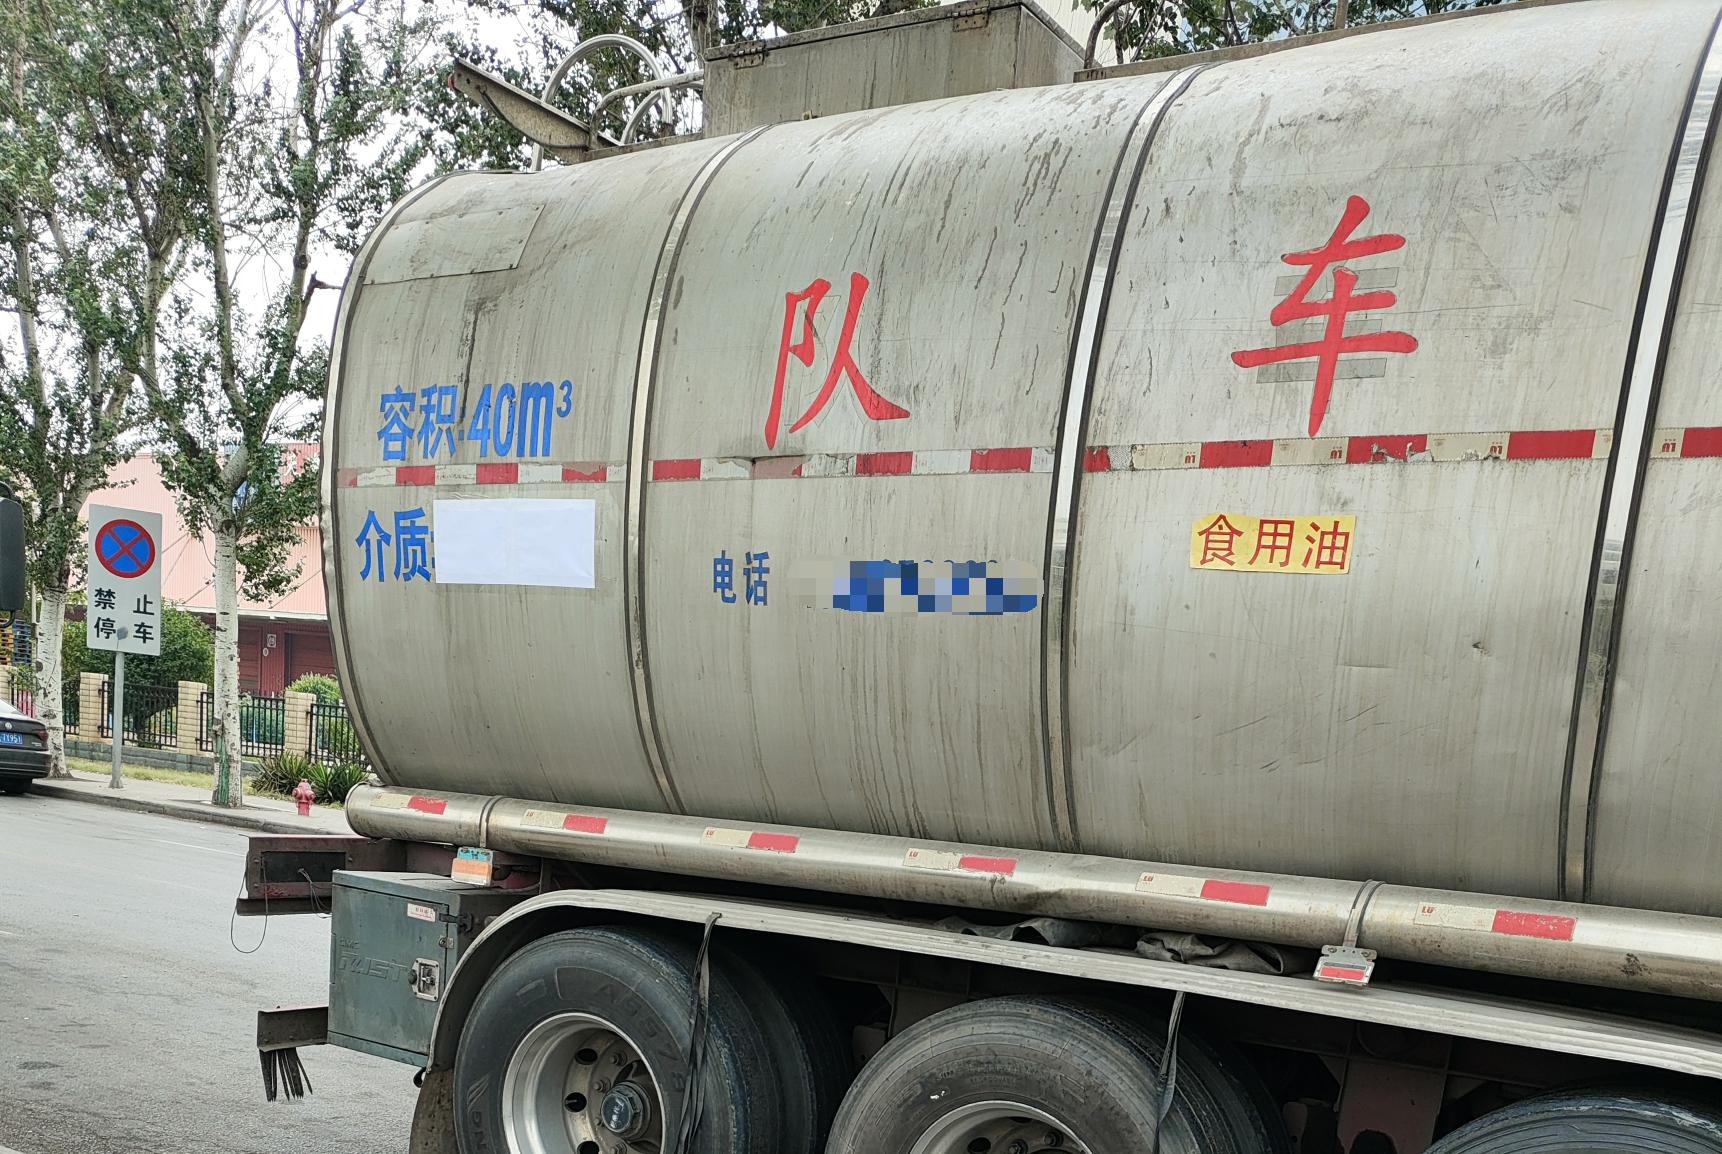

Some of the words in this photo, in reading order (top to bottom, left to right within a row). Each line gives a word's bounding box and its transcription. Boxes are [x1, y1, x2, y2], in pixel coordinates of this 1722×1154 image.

[1231, 195, 1419, 437] 车
[764, 272, 911, 450] 队
[1197, 514, 1351, 570] 食用油
[94, 588, 155, 615] 禁止
[713, 550, 770, 606] 电话
[94, 617, 155, 643] 停车
